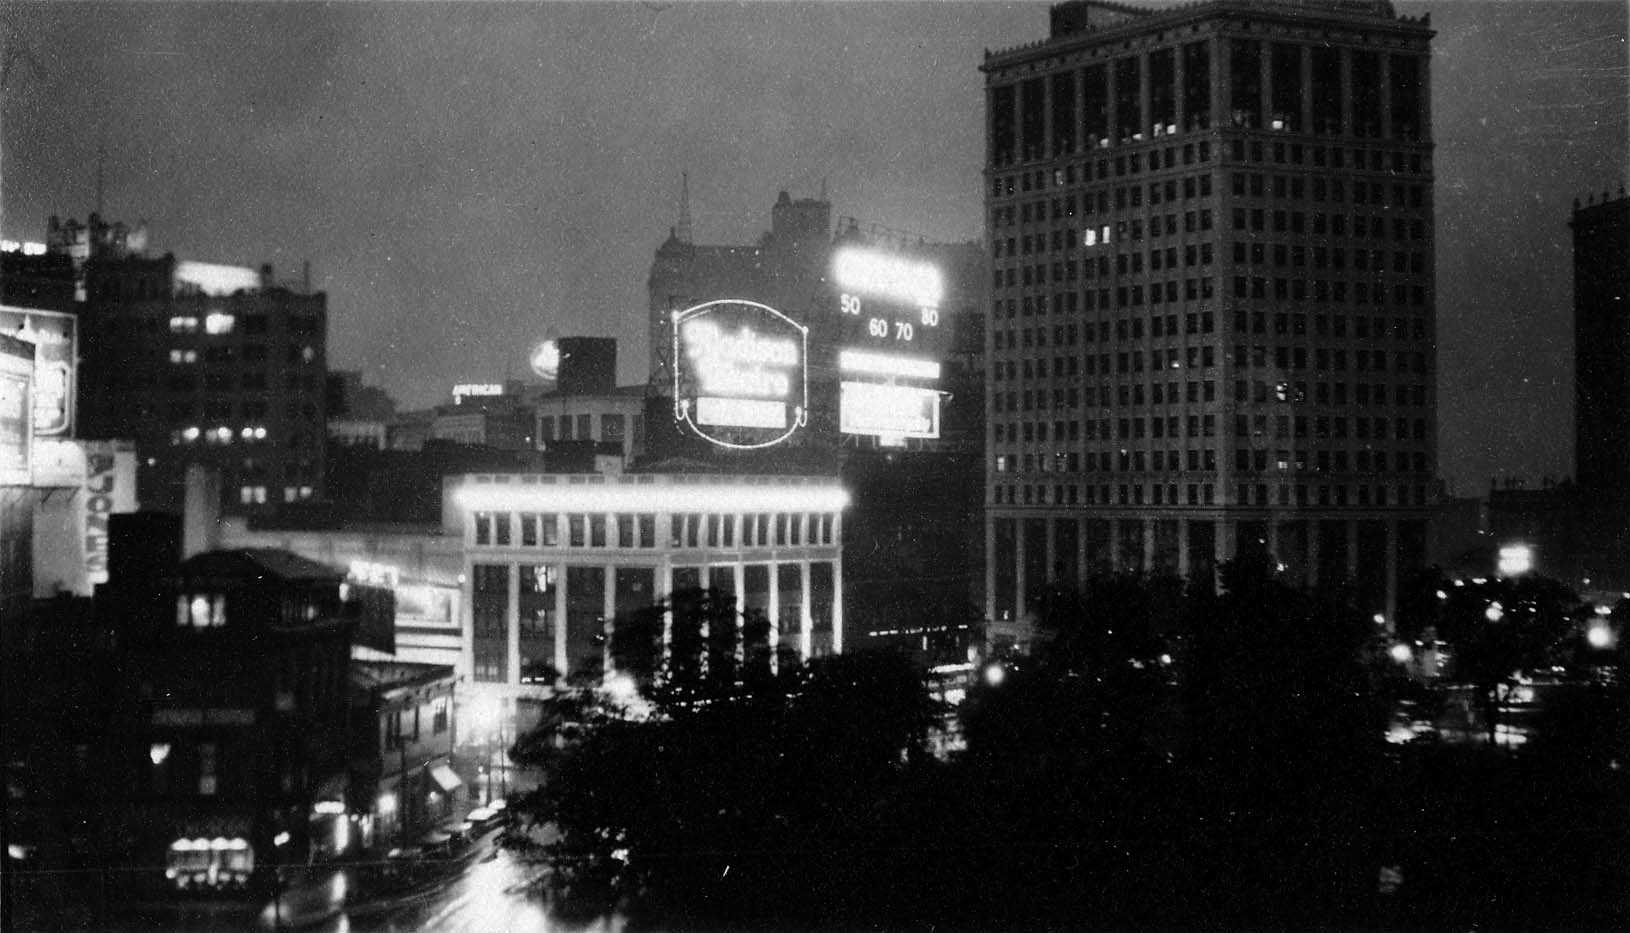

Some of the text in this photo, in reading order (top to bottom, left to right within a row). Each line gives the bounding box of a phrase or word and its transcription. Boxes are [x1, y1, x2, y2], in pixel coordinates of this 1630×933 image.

[840, 293, 939, 341] 50 60 70 80
